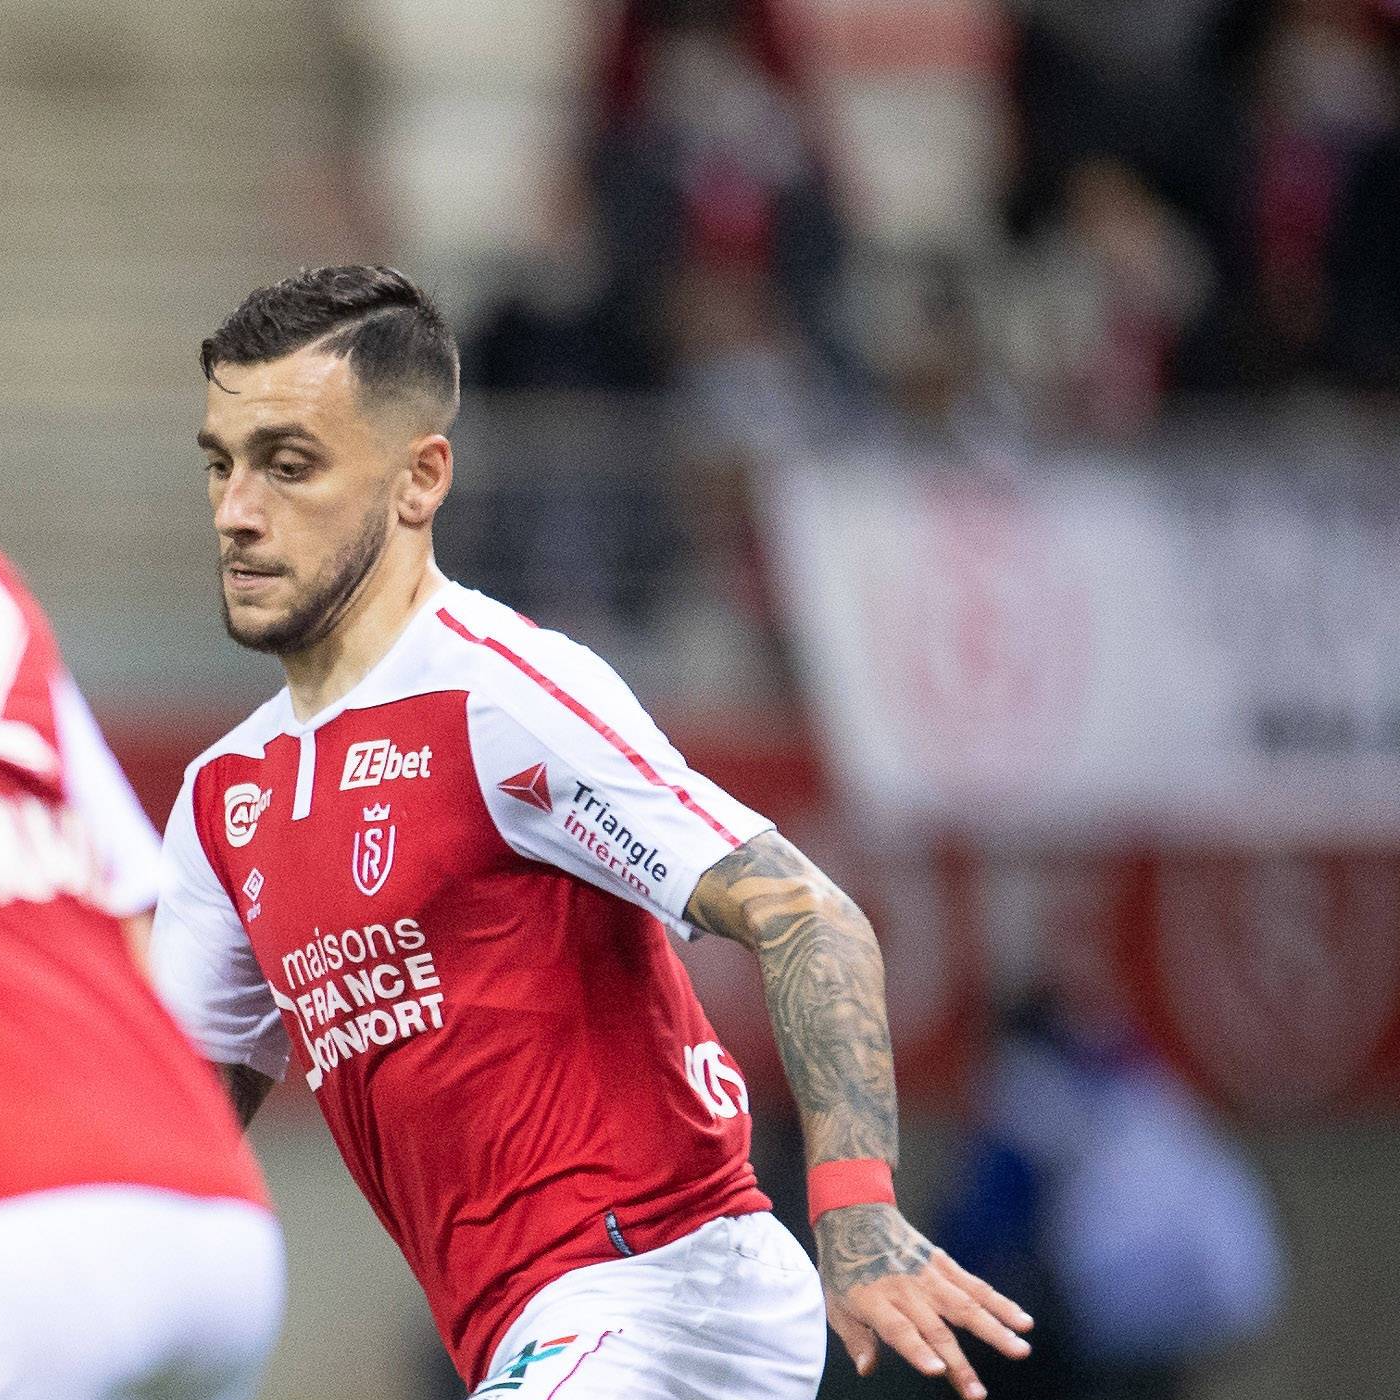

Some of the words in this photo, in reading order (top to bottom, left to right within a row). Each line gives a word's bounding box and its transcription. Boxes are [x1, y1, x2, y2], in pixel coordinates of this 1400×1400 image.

[572, 780, 667, 882] Triangle
[282, 918, 426, 990] maisons
[297, 952, 441, 1032] FRANCE
[314, 992, 444, 1072] CONFORT
